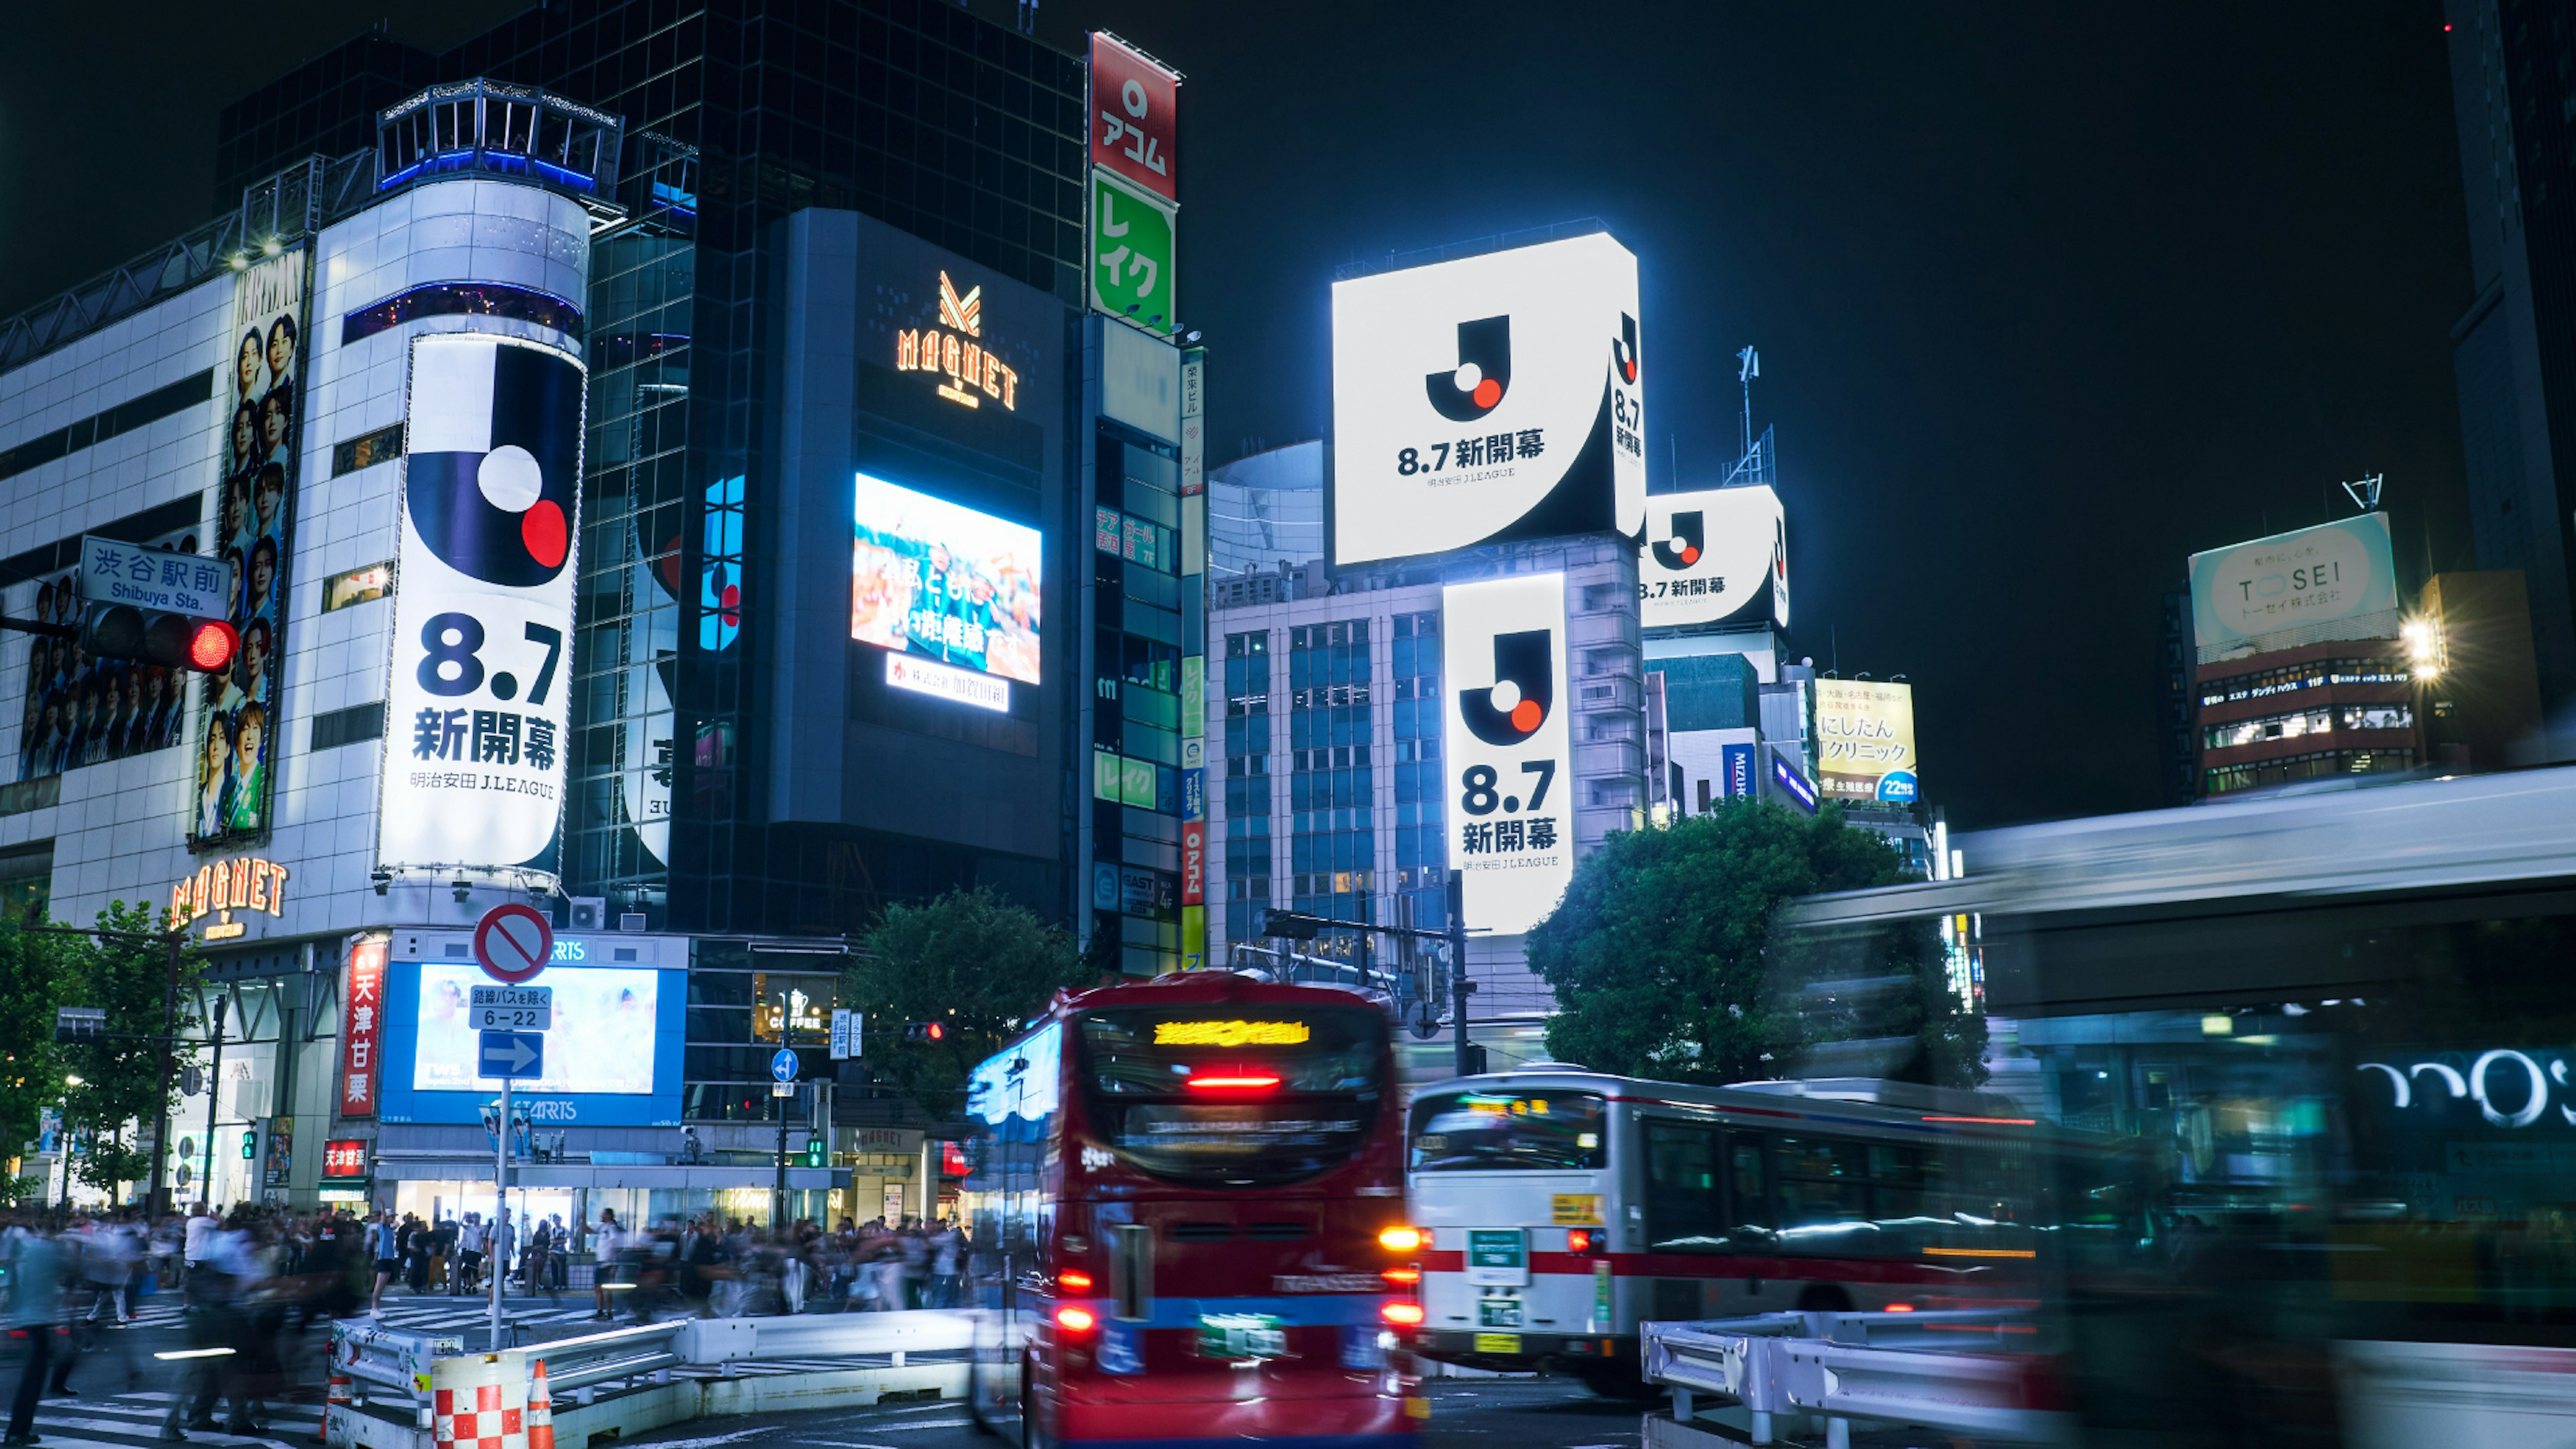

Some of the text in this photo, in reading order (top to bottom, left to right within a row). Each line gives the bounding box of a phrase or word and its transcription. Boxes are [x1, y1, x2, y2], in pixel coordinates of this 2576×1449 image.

[1102, 110, 1167, 176] アコム
[1099, 191, 1158, 297] レイク
[896, 328, 1018, 412] MAGNET
[1615, 388, 1640, 431] 8.7
[1397, 428, 1545, 477] 8.7 新開幕
[1096, 509, 1155, 544] チアガール
[1096, 529, 1136, 559] 居酒屋
[94, 547, 221, 594] 渋谷駅前
[1671, 576, 1725, 598] 新開幕
[2239, 561, 2339, 601] TOSEI
[111, 582, 203, 611] Shibuya Sta.
[416, 612, 562, 705] 8.7
[1186, 664, 1199, 704] レイク
[2229, 690, 2248, 701] エステ
[2308, 676, 2323, 688] 11F
[413, 706, 557, 771] 新開幕
[1821, 716, 1893, 739] にしたん
[410, 771, 553, 800] 明治安田 J.LEAGUE
[1104, 761, 1150, 794] レイク
[1462, 759, 1555, 816] 8.7
[1735, 752, 1747, 803] MIZUHO
[1462, 816, 1558, 855] 新開幕
[1123, 875, 1154, 890] EAST
[1187, 850, 1200, 894] アコム
[1503, 857, 1559, 869] J.LEAGUE
[170, 858, 286, 932] MAGNET
[1159, 890, 1173, 909] 4F
[474, 989, 547, 1005] 路線バスを除く
[347, 974, 375, 1103] 天津甘栗
[325, 1148, 366, 1167] 天津甘栗
[861, 1129, 902, 1147] MAGNET
